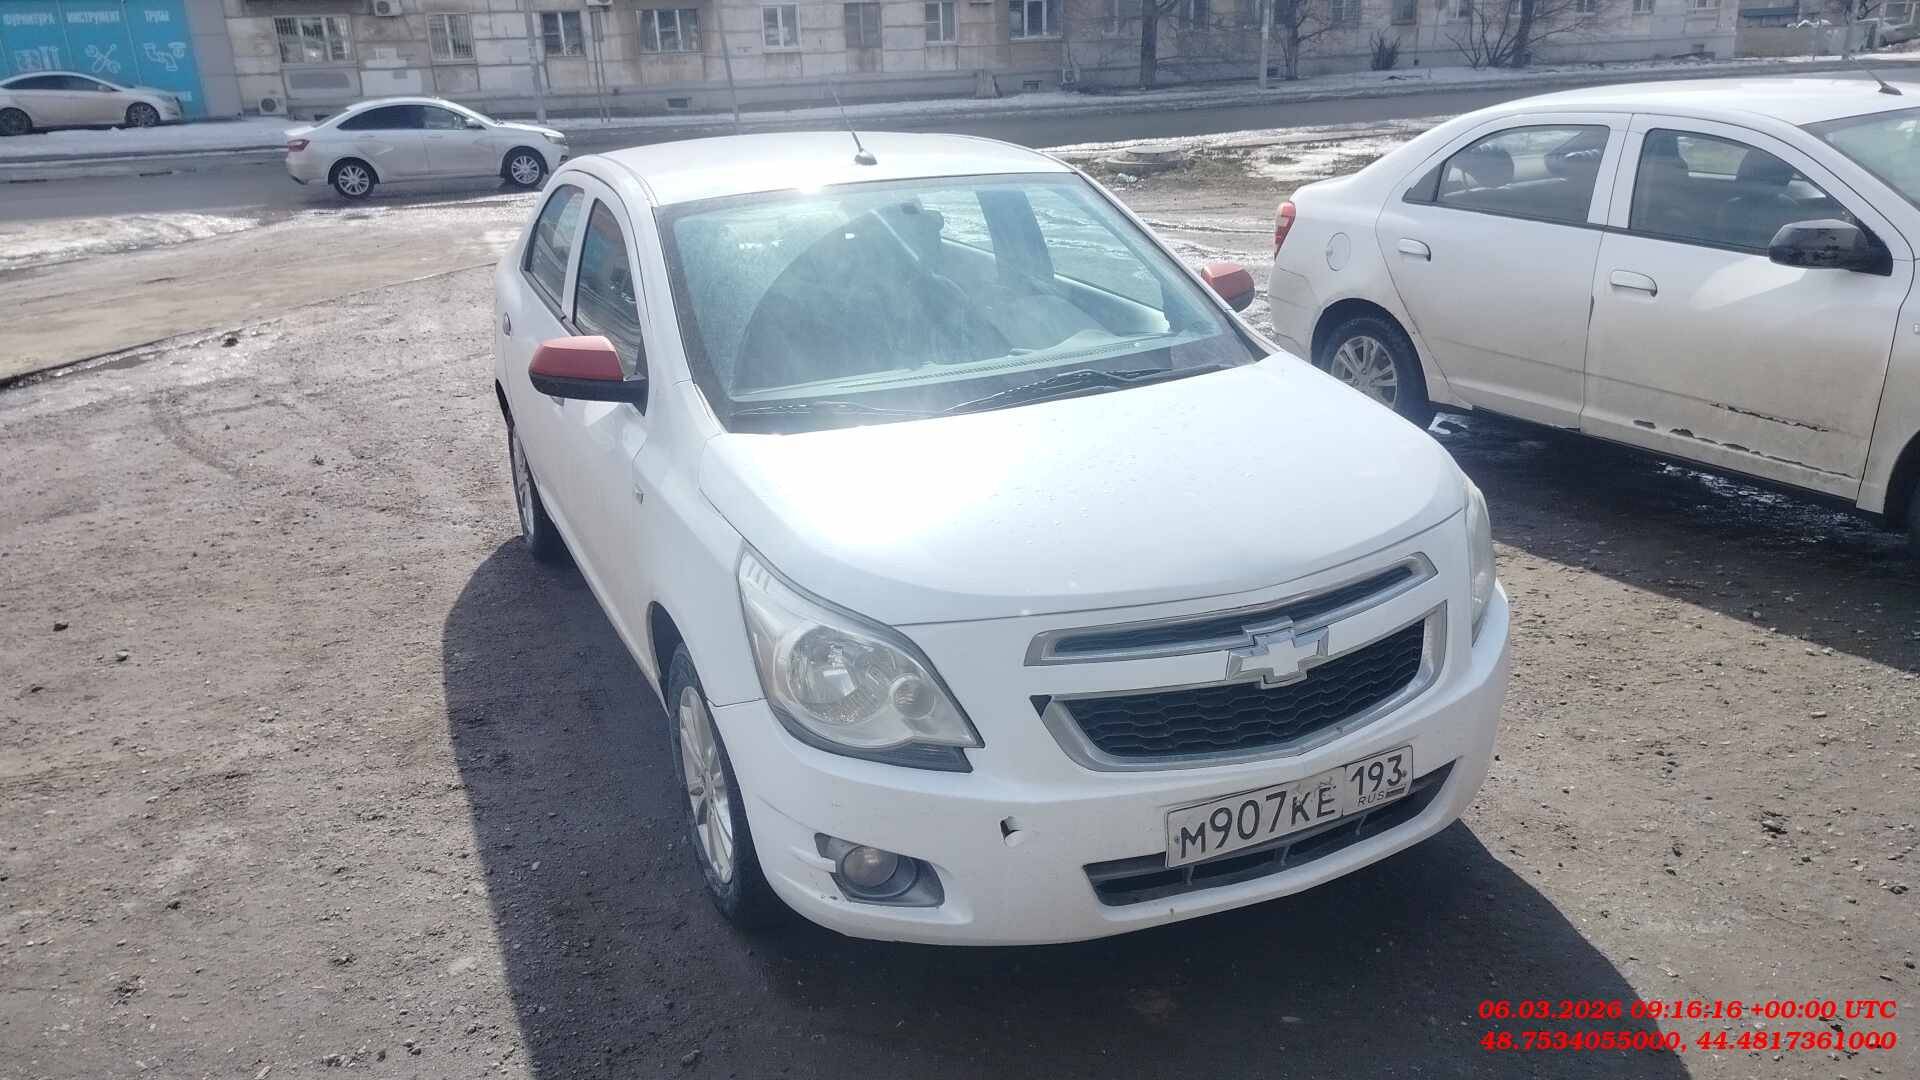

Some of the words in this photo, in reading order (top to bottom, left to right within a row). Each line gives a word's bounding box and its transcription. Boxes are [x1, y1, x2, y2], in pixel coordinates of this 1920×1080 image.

[66, 11, 120, 24] ИНСТРУМЕНТ
[1350, 754, 1403, 796] 193
[1357, 791, 1385, 807] RUS
